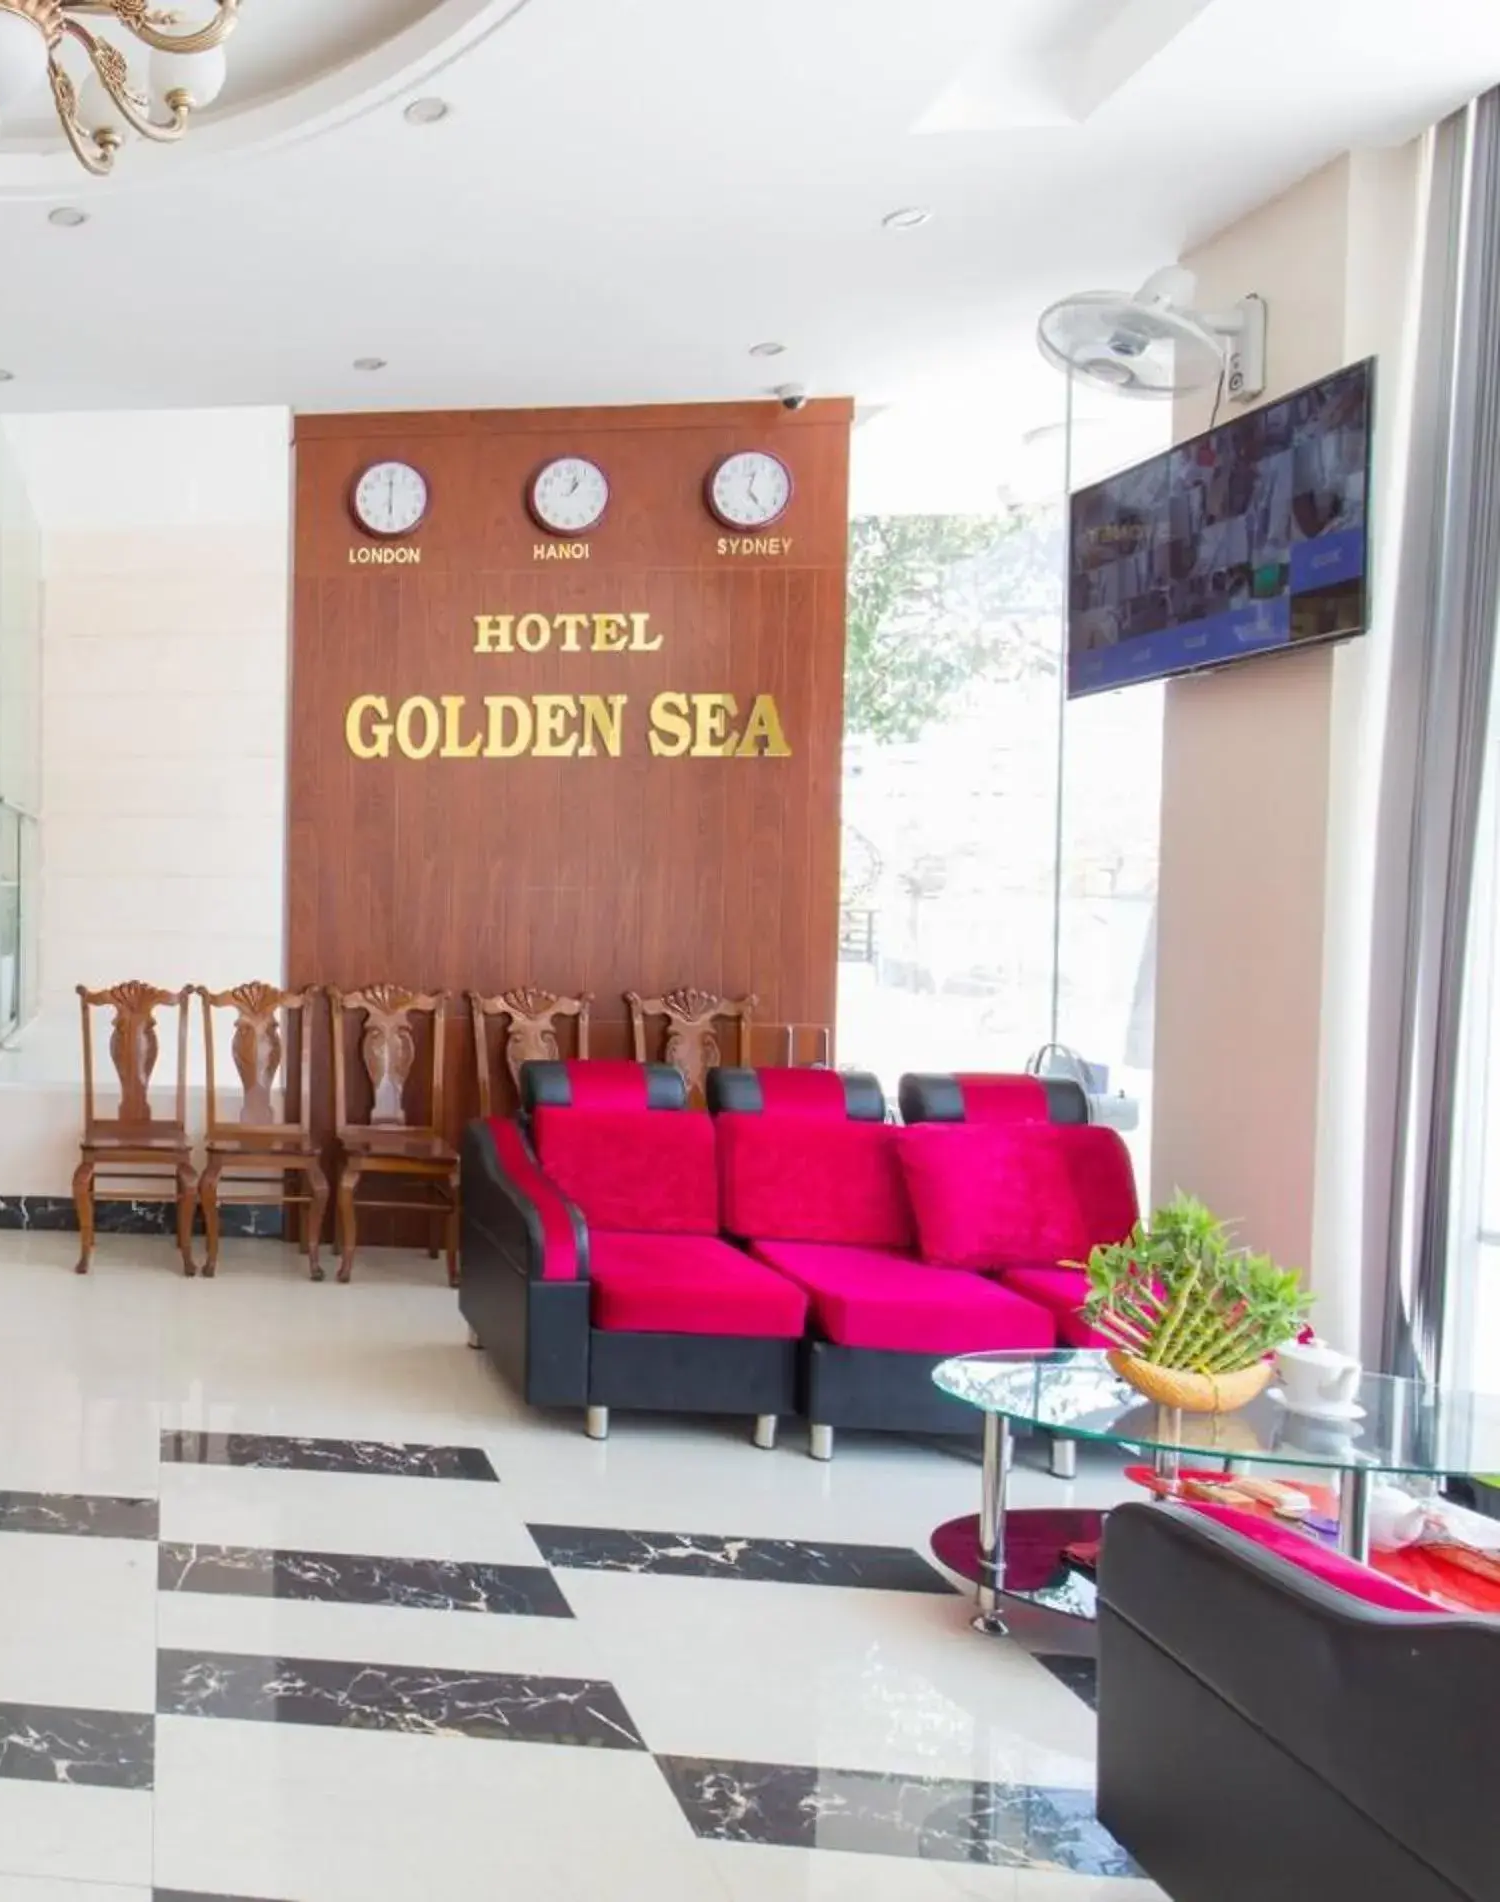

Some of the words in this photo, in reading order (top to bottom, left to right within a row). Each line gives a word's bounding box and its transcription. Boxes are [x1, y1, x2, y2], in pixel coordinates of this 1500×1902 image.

[533, 544, 590, 560] HANOI
[717, 537, 793, 555] SYDNEY
[348, 547, 421, 564] LONDON
[474, 613, 663, 652] HOTEL
[345, 694, 627, 759] GOLDEN
[648, 692, 791, 758] SEA
